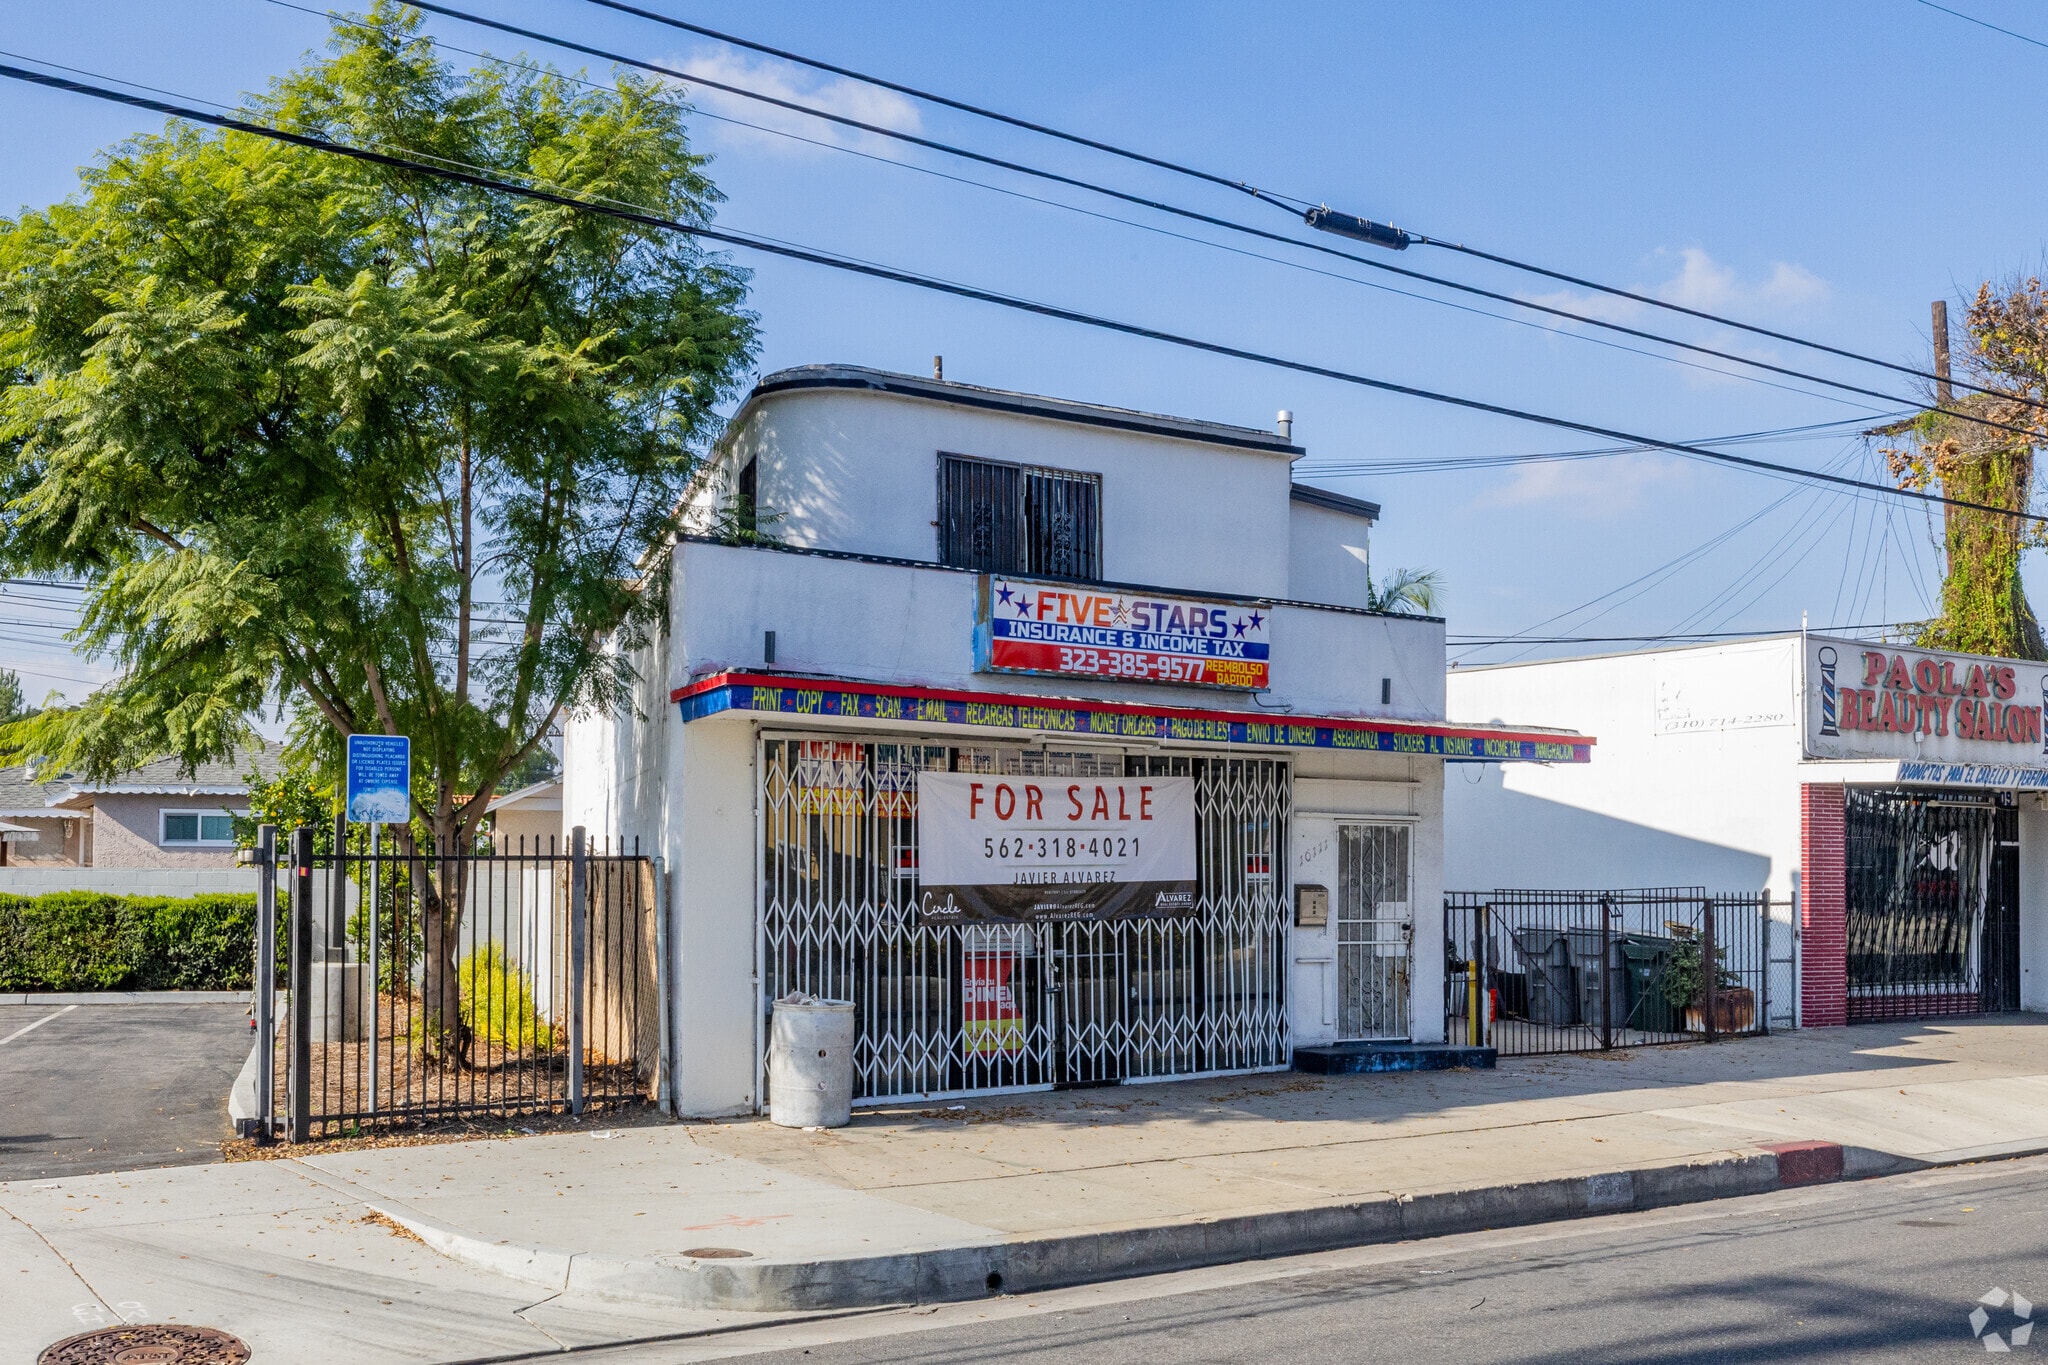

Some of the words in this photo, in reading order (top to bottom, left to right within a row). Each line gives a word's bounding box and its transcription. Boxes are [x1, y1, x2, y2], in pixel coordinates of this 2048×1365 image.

[1037, 590, 1113, 627] FIVE
[1131, 601, 1227, 638] STARS
[1009, 621, 1117, 646] INSURANCE
[1122, 633, 1135, 647] &
[1140, 634, 1208, 654] INCOME
[1213, 641, 1244, 657] TAX
[1060, 648, 1205, 681] 323-385-9577
[1205, 660, 1262, 676] REEMBOLSO
[1861, 651, 2016, 699] PAOLA'S
[1217, 674, 1252, 686] RAPIDO
[752, 686, 783, 711] PRINT
[796, 689, 823, 714] COPY
[840, 693, 859, 716] FAX
[875, 695, 901, 718] SCAN
[966, 702, 1013, 726] RECARGAS
[1018, 707, 1075, 731] TELEFONICAS
[1090, 711, 1119, 733] MONEY
[1122, 714, 1156, 735] ORDERS
[1172, 717, 1192, 738] PAGO
[1194, 720, 1204, 739] DE
[1246, 722, 1270, 743] ENVIO
[1274, 724, 1285, 743] DE
[1288, 725, 1316, 744] DINERO
[1332, 728, 1379, 749] ASEGURANZA
[1393, 732, 1425, 752] STICKERS
[1430, 735, 1439, 753] AL
[1484, 738, 1508, 757] INCOME
[1509, 740, 1520, 757] TAX
[1665, 720, 1704, 732] (310)
[1837, 687, 1952, 736] BEAUTY
[1955, 698, 2042, 743] SALON
[800, 762, 864, 788] TAX
[1900, 763, 1945, 782] PRODUCTOS
[1965, 767, 1976, 783] EL
[2010, 770, 2019, 785] Y
[970, 783, 1043, 820] FOR
[1067, 785, 1153, 821] SALE
[1013, 871, 1056, 885] JAVIER
[1064, 871, 1115, 884] ALVAREZ
[922, 891, 961, 916] Circle
[1155, 891, 1191, 906] ALVAREZ
